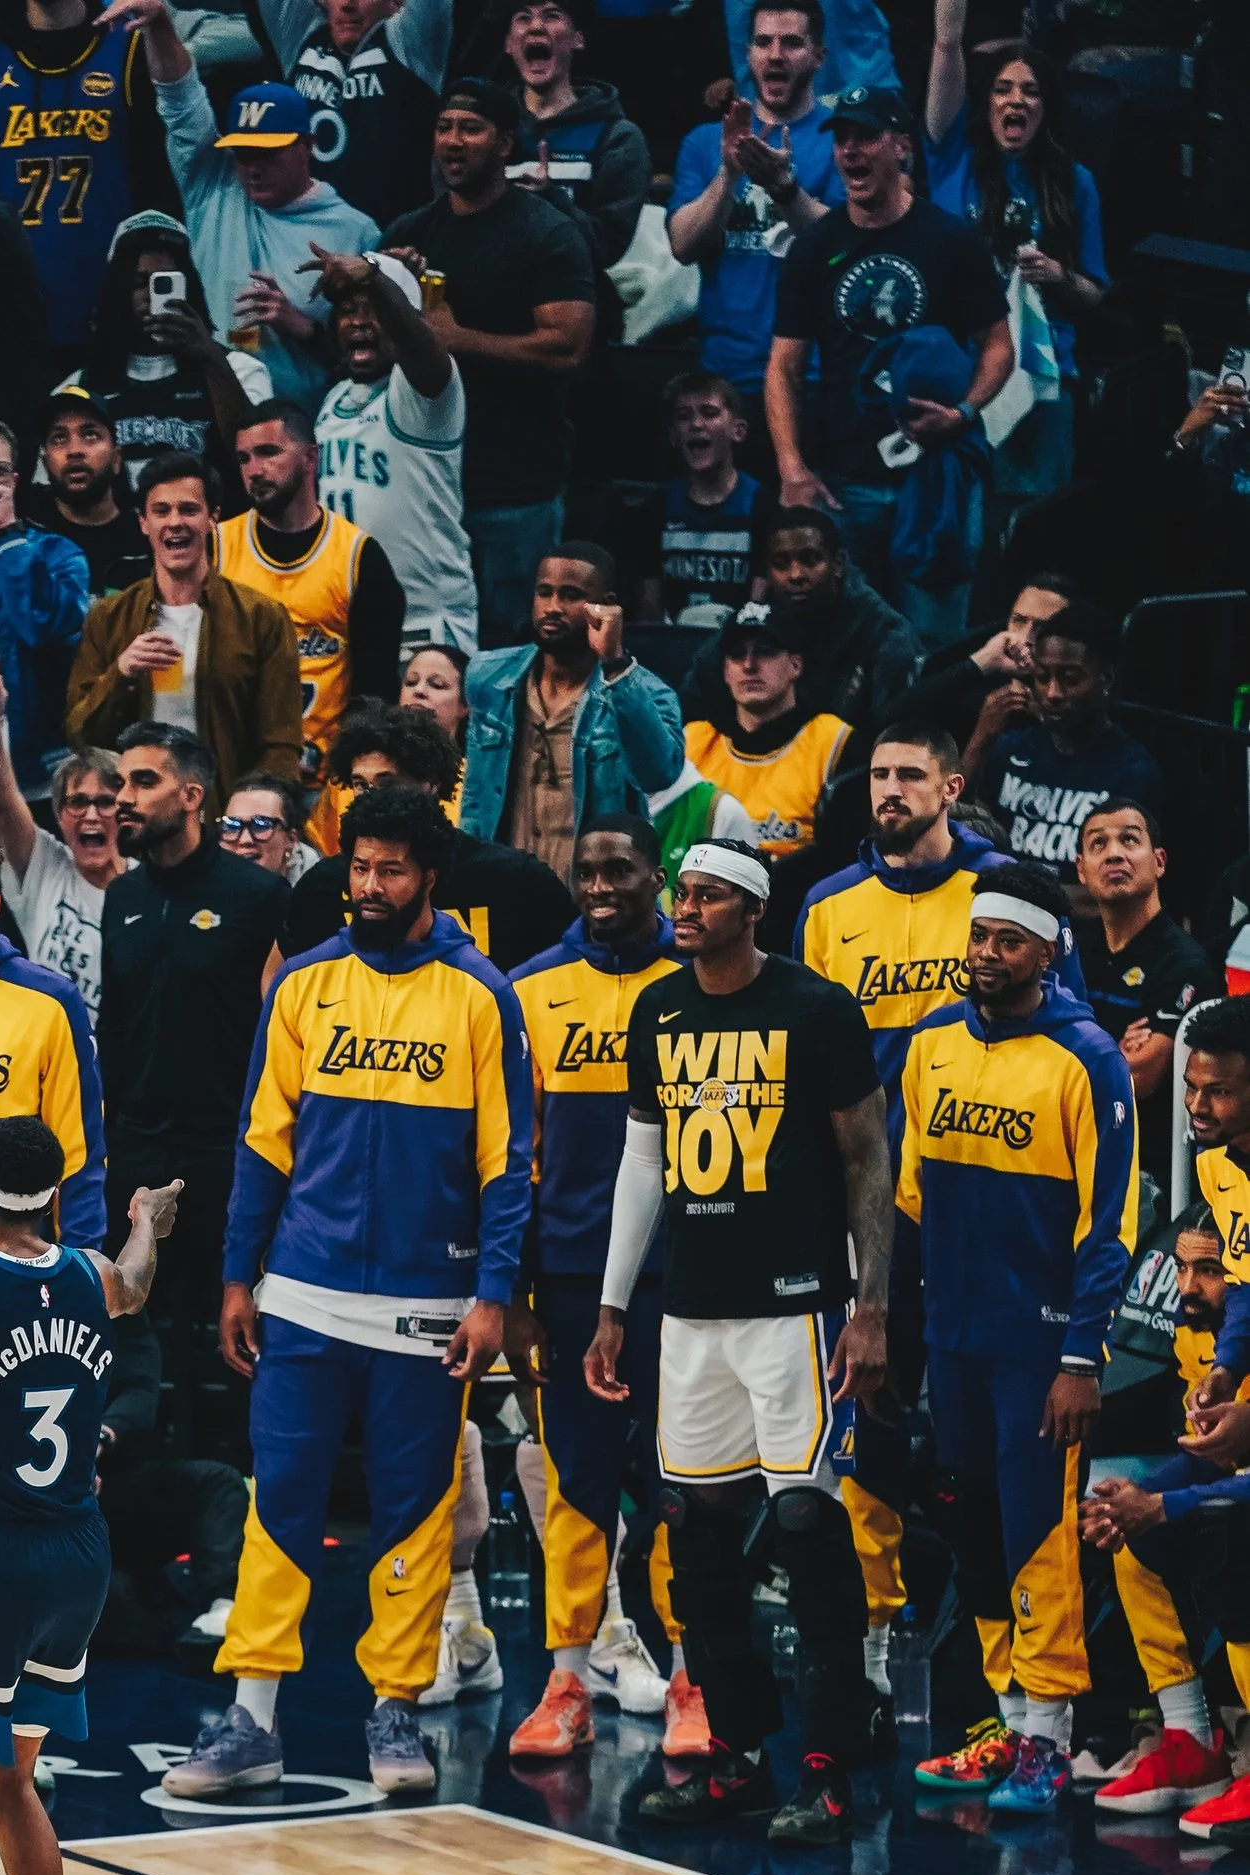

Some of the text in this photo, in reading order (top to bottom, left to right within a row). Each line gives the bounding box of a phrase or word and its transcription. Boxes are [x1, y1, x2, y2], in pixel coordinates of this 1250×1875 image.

[0, 105, 112, 148] LAKERS
[237, 101, 276, 128] W
[16, 156, 92, 226] 77
[317, 1025, 447, 1082] LAKERS
[656, 1030, 788, 1083] WIN
[656, 1083, 693, 1107] FOR
[737, 1083, 785, 1106] THE
[927, 1087, 1036, 1150] LAKERS
[664, 1106, 784, 1196] JOY
[15, 1387, 76, 1488] 3
